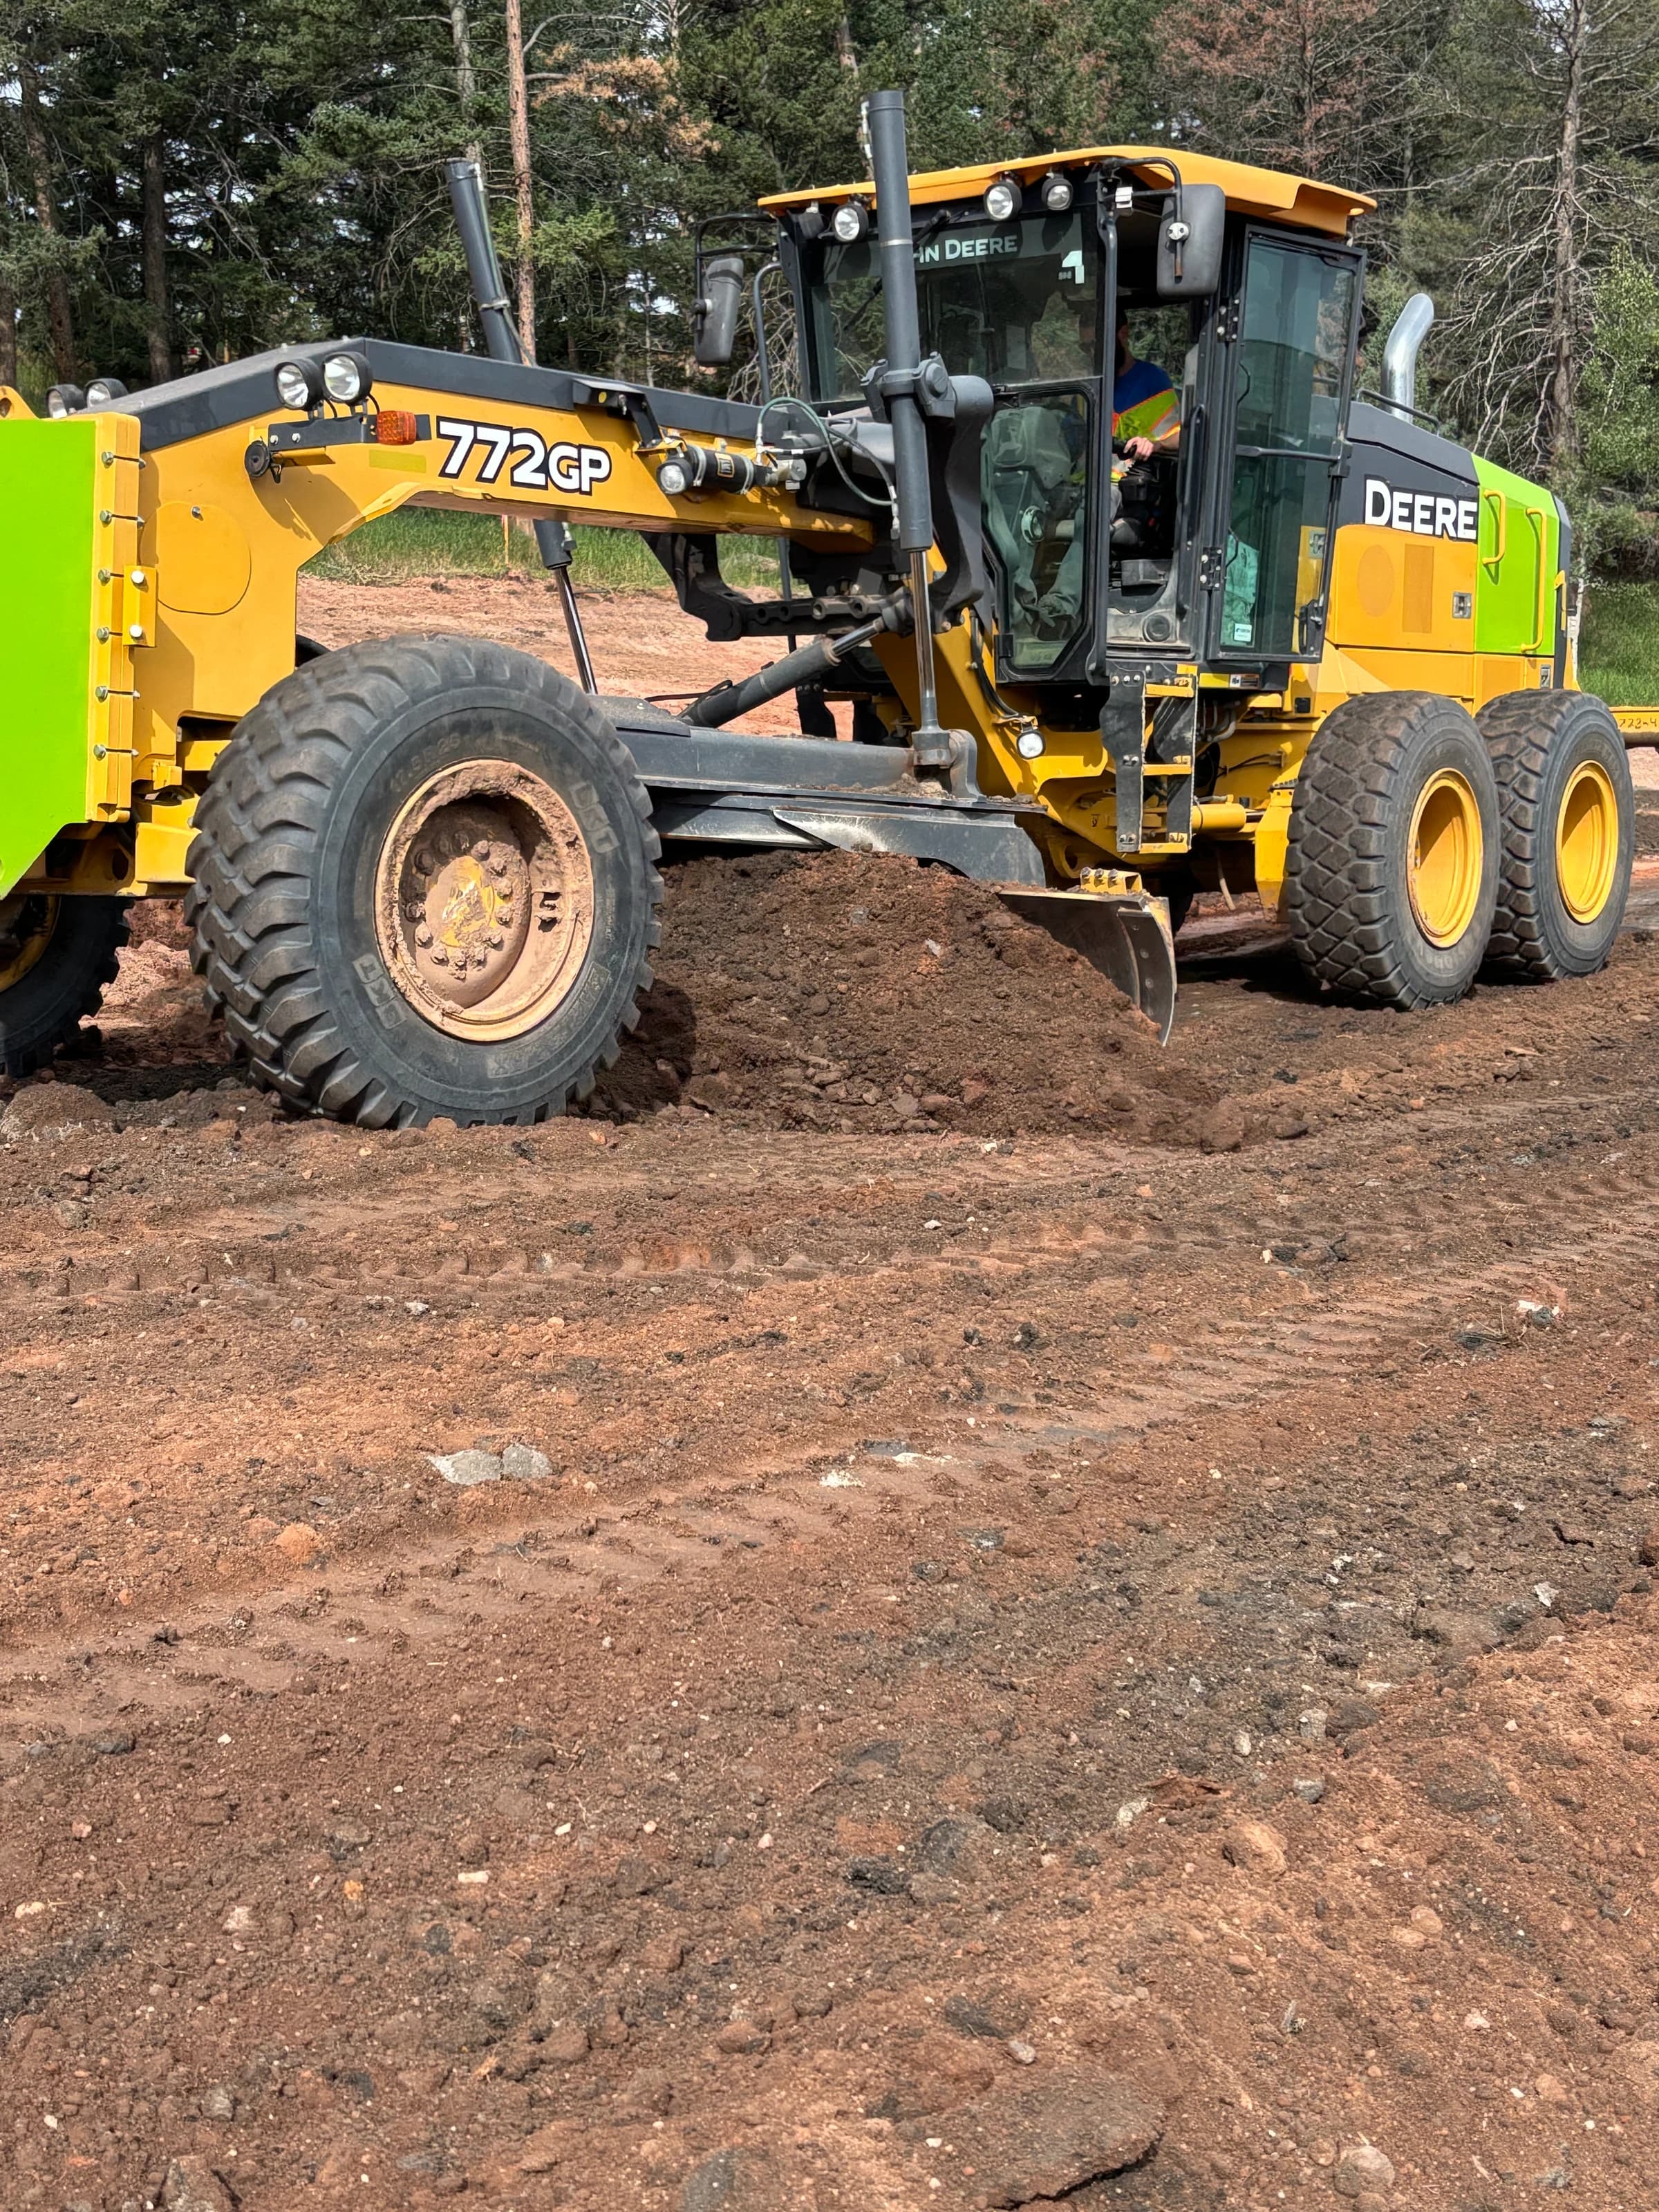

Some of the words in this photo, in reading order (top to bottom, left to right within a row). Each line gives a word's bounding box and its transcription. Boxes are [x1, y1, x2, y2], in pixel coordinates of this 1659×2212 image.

[945, 235, 1018, 260] DEERE
[438, 418, 612, 495] 772GP
[1365, 478, 1478, 540] DEERE
